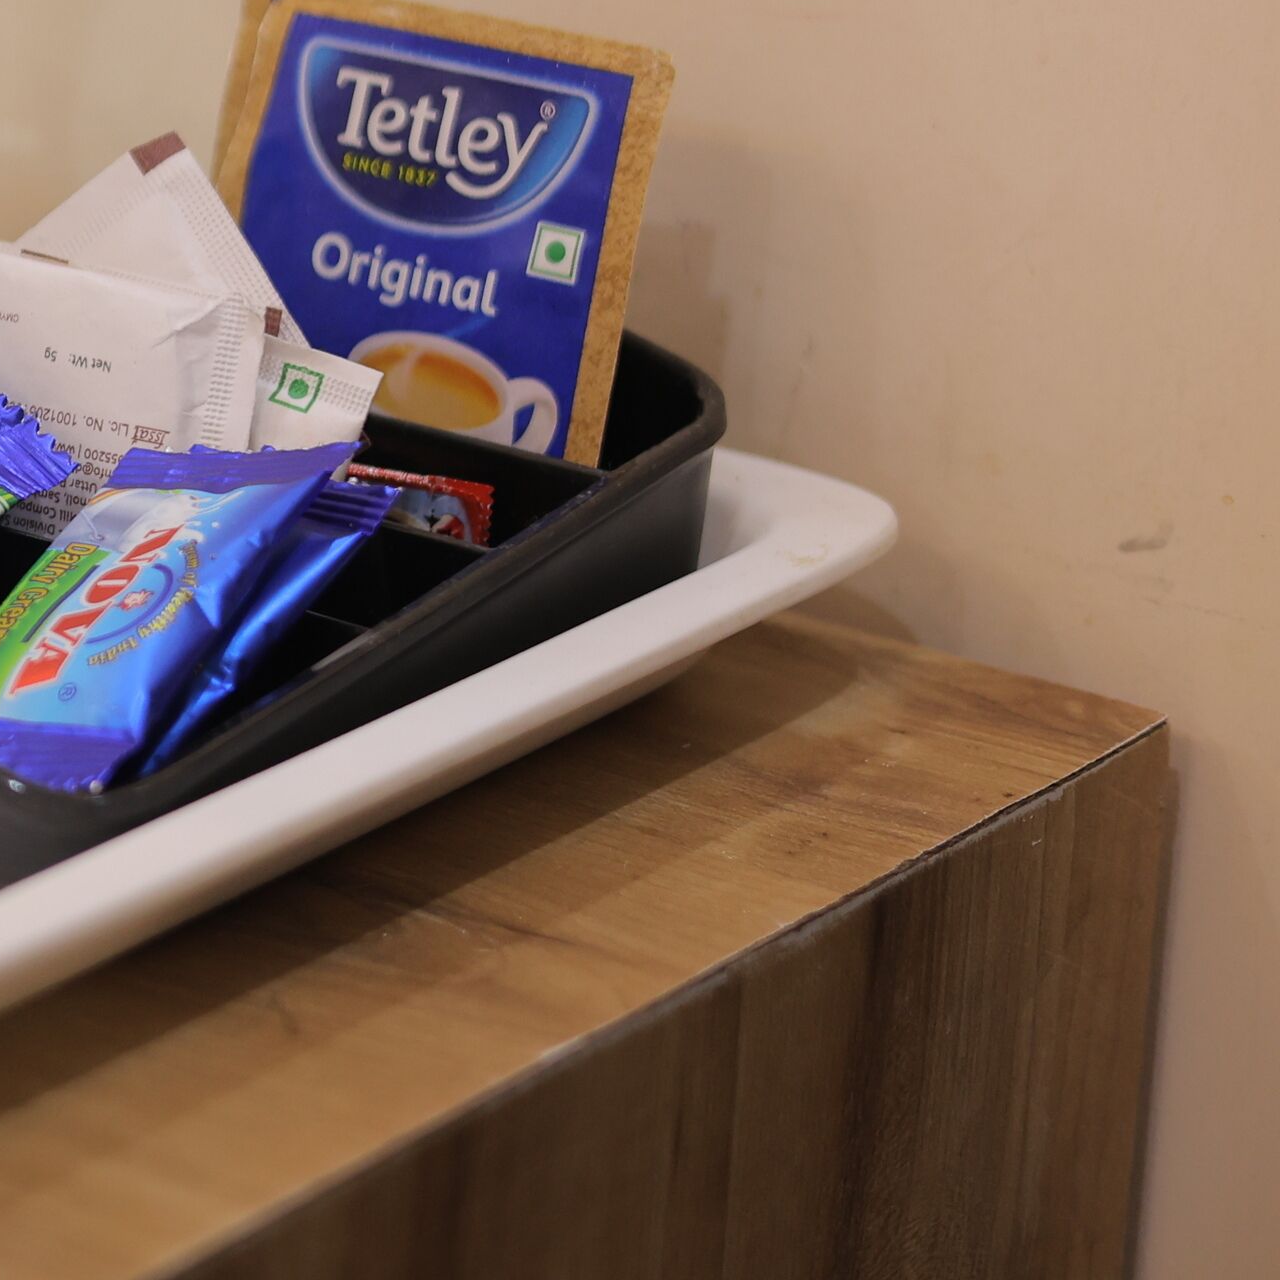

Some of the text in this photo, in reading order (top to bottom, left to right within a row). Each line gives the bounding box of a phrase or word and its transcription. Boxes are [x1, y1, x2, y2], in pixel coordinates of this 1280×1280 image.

[336, 66, 548, 199] Tetley
[342, 152, 438, 188] SINCE 1837
[312, 231, 499, 317] Original
[44, 347, 112, 373] Net Wt: 5g
[83, 416, 104, 431] No.
[111, 421, 130, 436] Lic.
[69, 478, 98, 493] Uttar
[16, 517, 56, 535] Division
[30, 541, 100, 585] Dairy
[9, 523, 185, 695] NOVA
